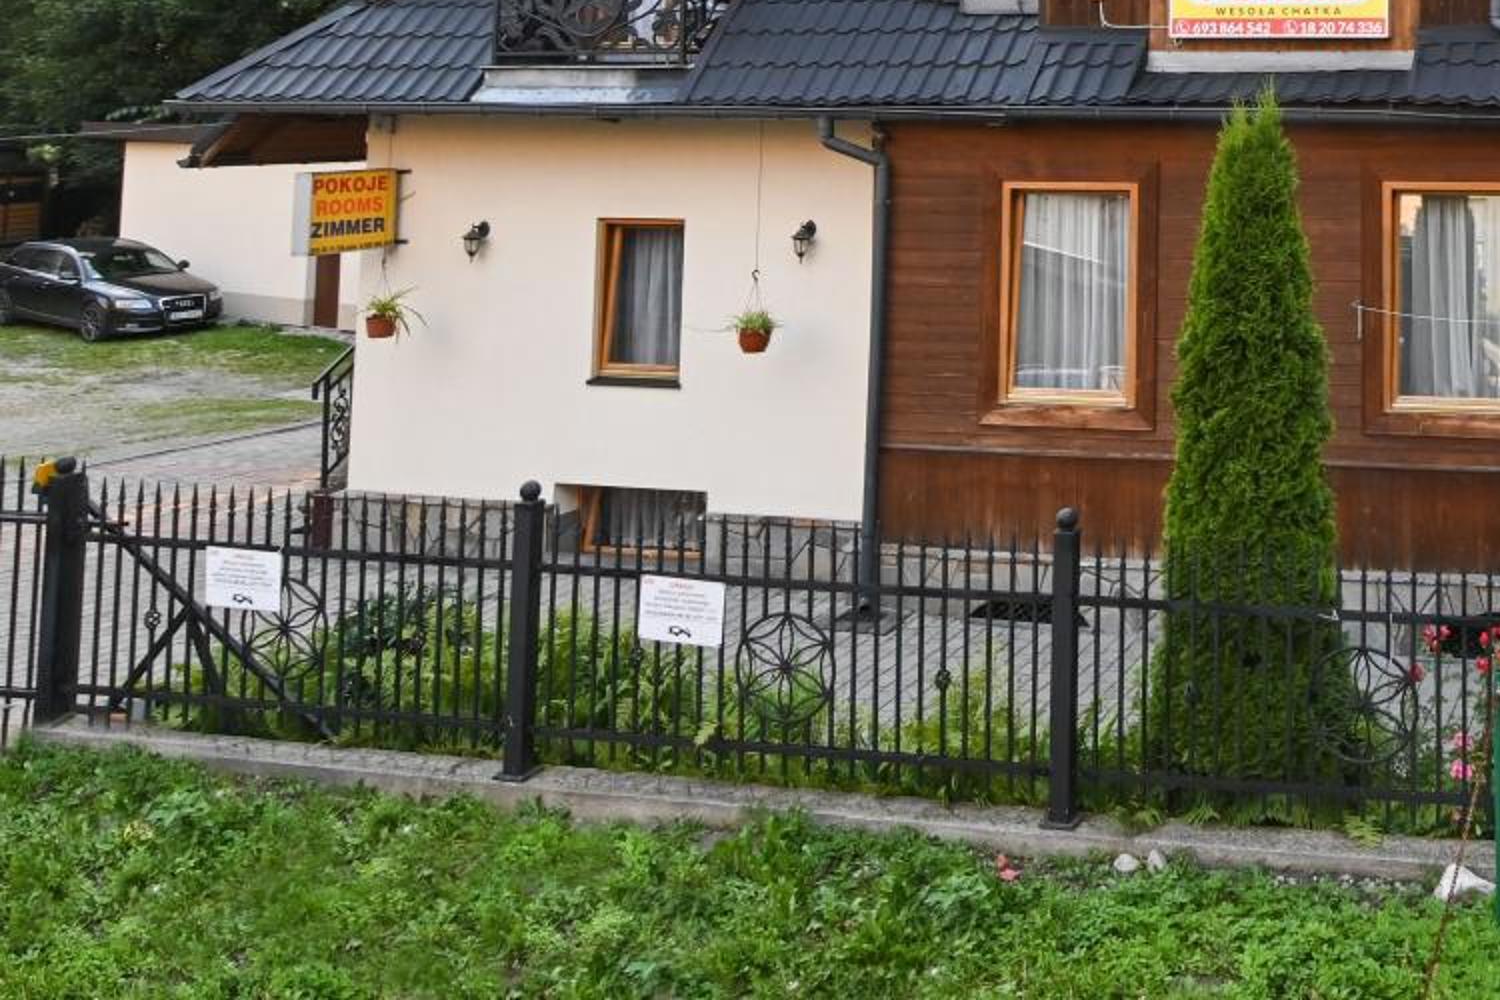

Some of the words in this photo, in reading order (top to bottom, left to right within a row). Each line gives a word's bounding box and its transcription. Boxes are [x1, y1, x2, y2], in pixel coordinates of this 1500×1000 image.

[1282, 7, 1342, 16] CHATKA
[1193, 21, 1217, 34] 693
[1300, 22, 1317, 34] 18
[1318, 22, 1336, 34] 20
[1337, 22, 1354, 34] 74
[313, 176, 388, 195] POKOJE
[316, 197, 384, 216] ROOMS
[311, 218, 385, 238] ZIMMER
